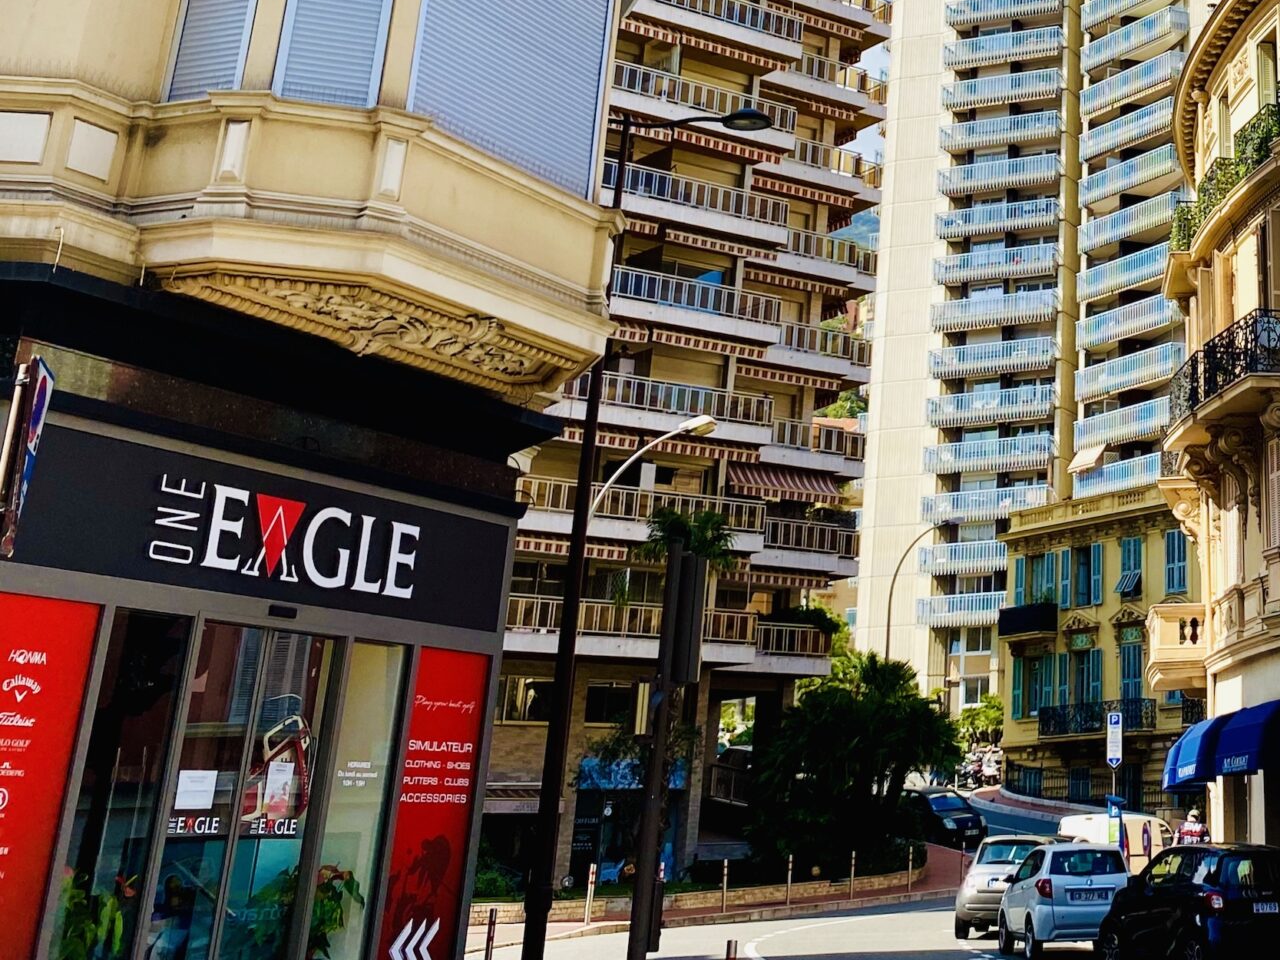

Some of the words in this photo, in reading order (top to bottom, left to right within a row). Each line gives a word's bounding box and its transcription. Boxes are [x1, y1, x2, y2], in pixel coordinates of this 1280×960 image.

[149, 473, 207, 565] ONE
[200, 484, 421, 599] EAGLE
[8, 649, 47, 665] HONMA
[2, 674, 41, 694] Callaway
[1111, 715, 1119, 724] P
[408, 739, 473, 753] SIMULATEUR
[404, 759, 441, 769] CLOTHING
[402, 776, 438, 786] PUTTERS
[399, 793, 467, 803] ACCESSORIES
[176, 816, 220, 834] EAGLE
[258, 818, 298, 835] EAGLE
